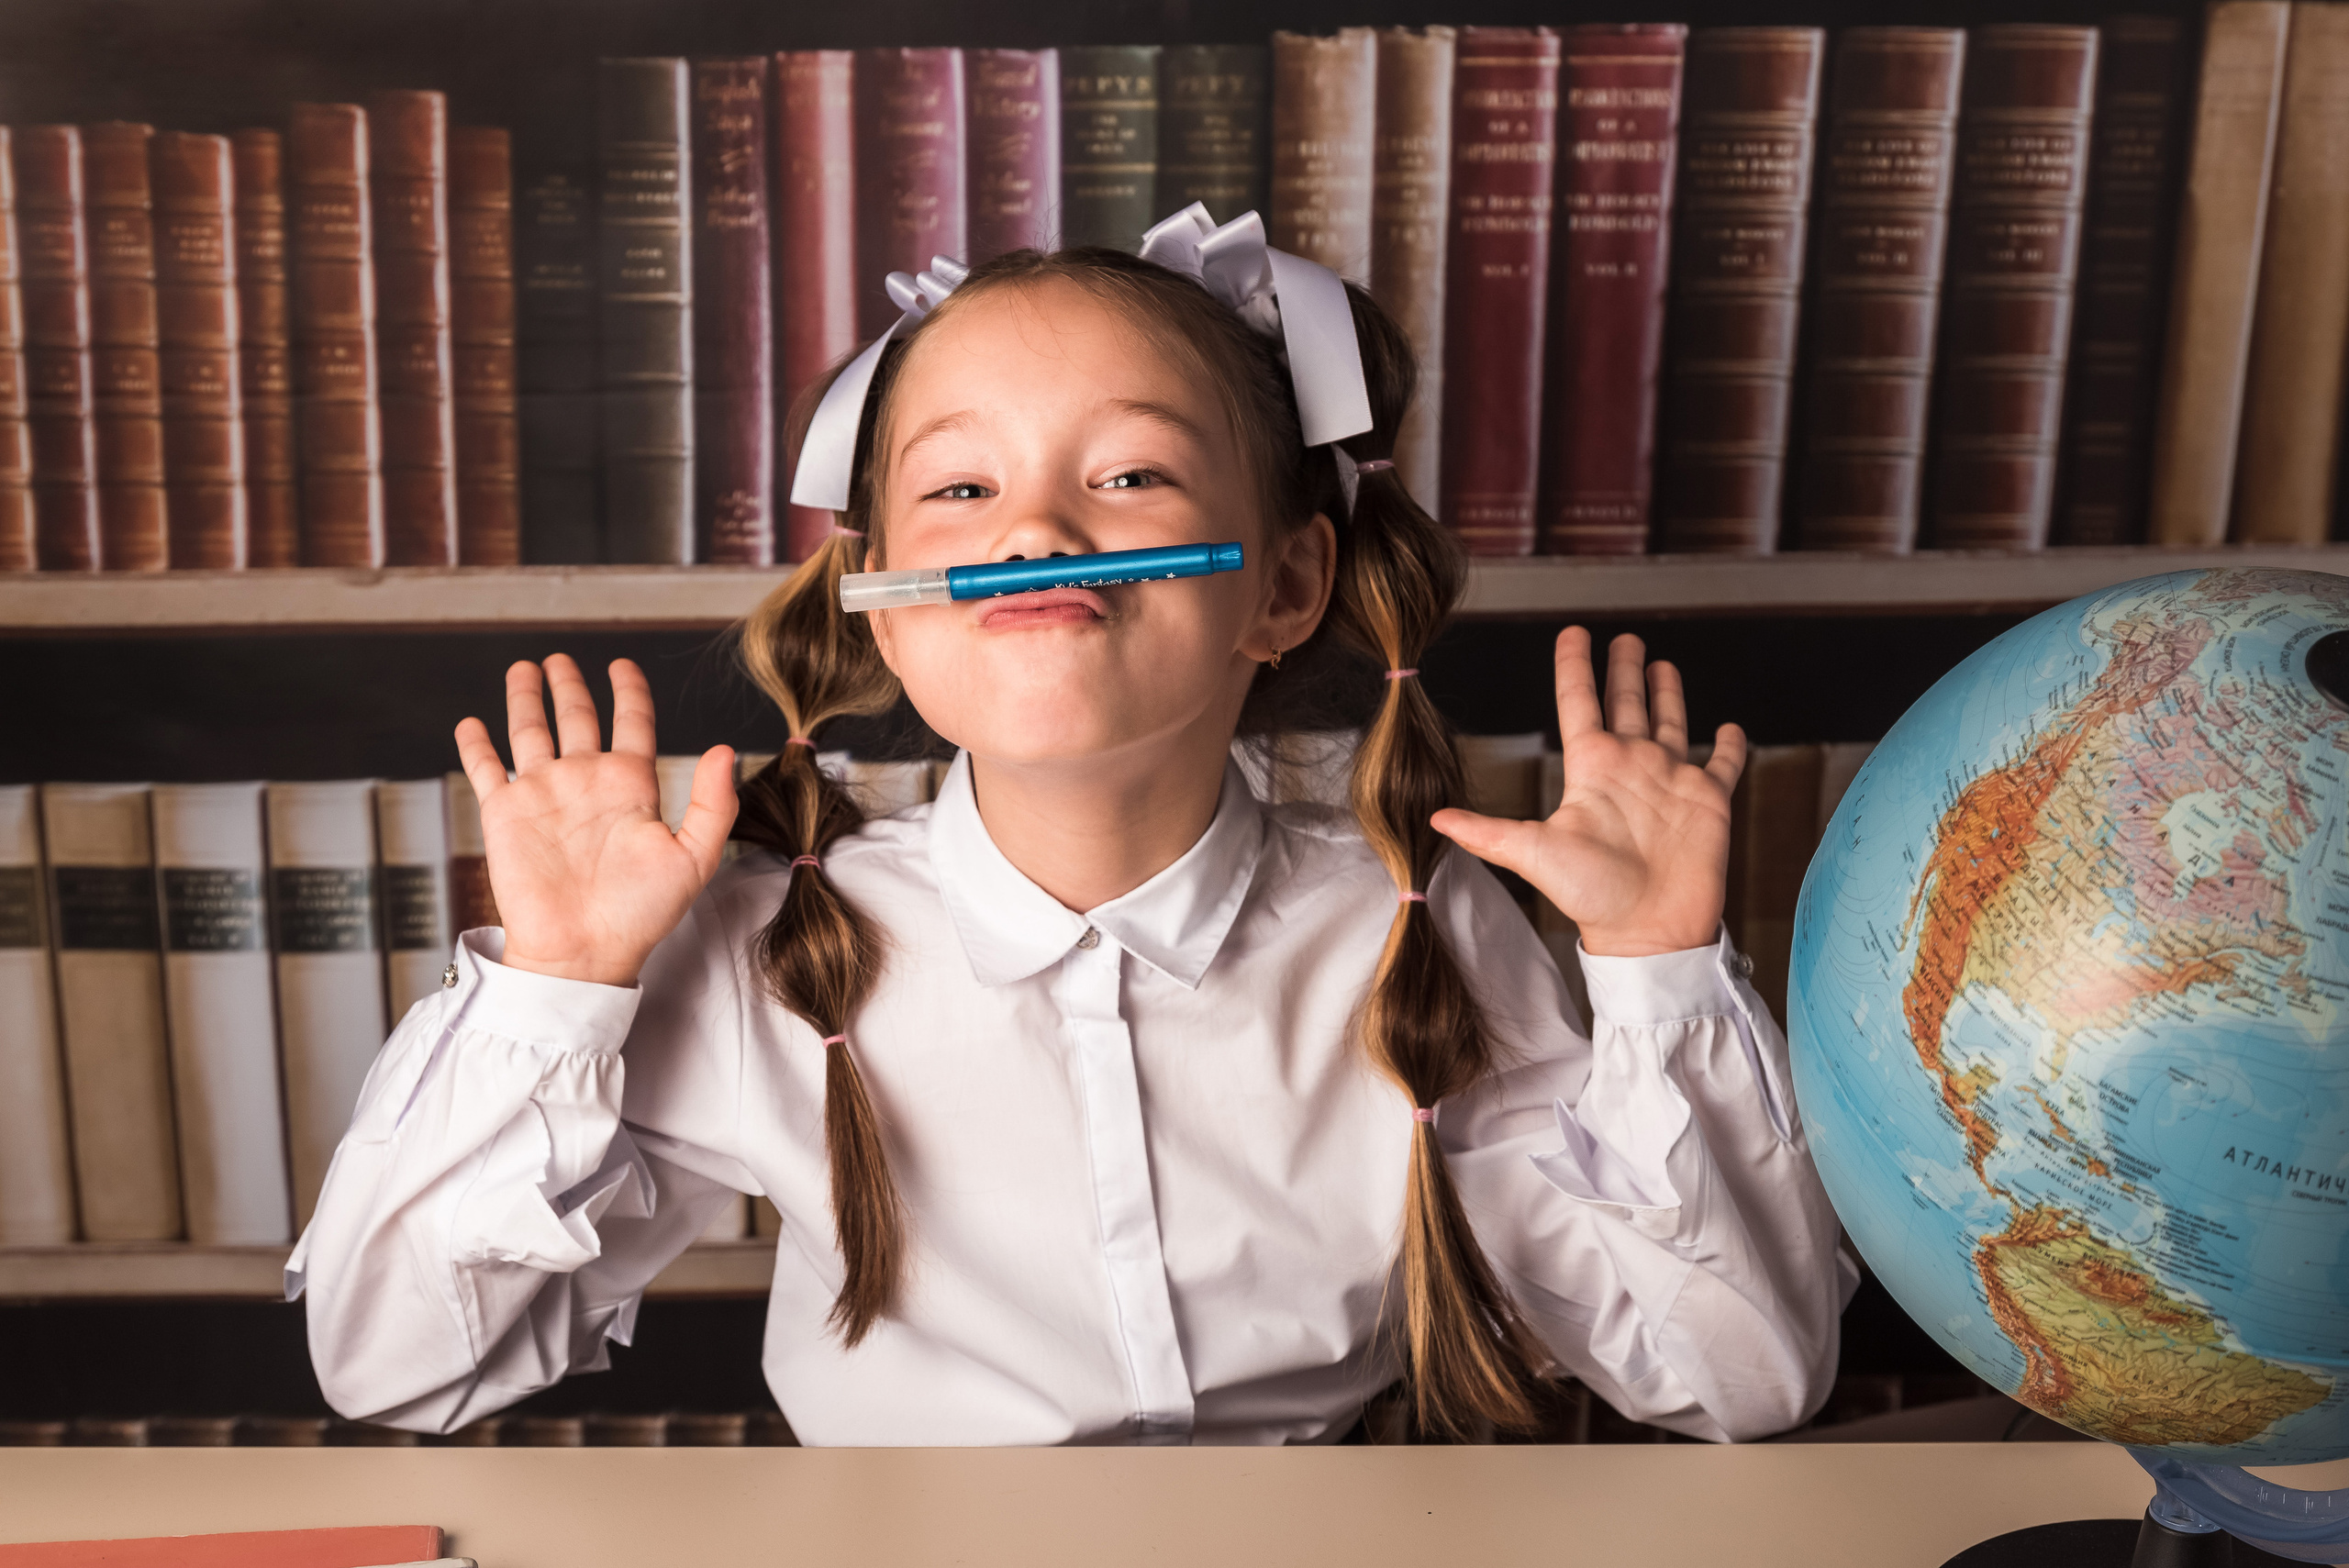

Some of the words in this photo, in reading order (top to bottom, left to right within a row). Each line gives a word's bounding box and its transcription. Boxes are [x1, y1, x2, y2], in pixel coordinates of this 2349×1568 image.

[1082, 578, 1123, 588] Fantasy
[2099, 1081, 2137, 1105] БАГАМСКИЕ
[2099, 1093, 2130, 1113] ОСТРОВА
[1970, 1101, 2003, 1130] ГОНДУРАС
[2044, 1100, 2066, 1116] КУБА
[2105, 1141, 2160, 1176] ДОМИНИКАНСКАЯ
[2113, 1156, 2153, 1181] РЕСПУБЛИКА
[2222, 1146, 2347, 1193] АТЛАНТИЧ
[2033, 1162, 2085, 1195] КАРИБСКОЕ
[2088, 1193, 2112, 1210] МОРЕ
